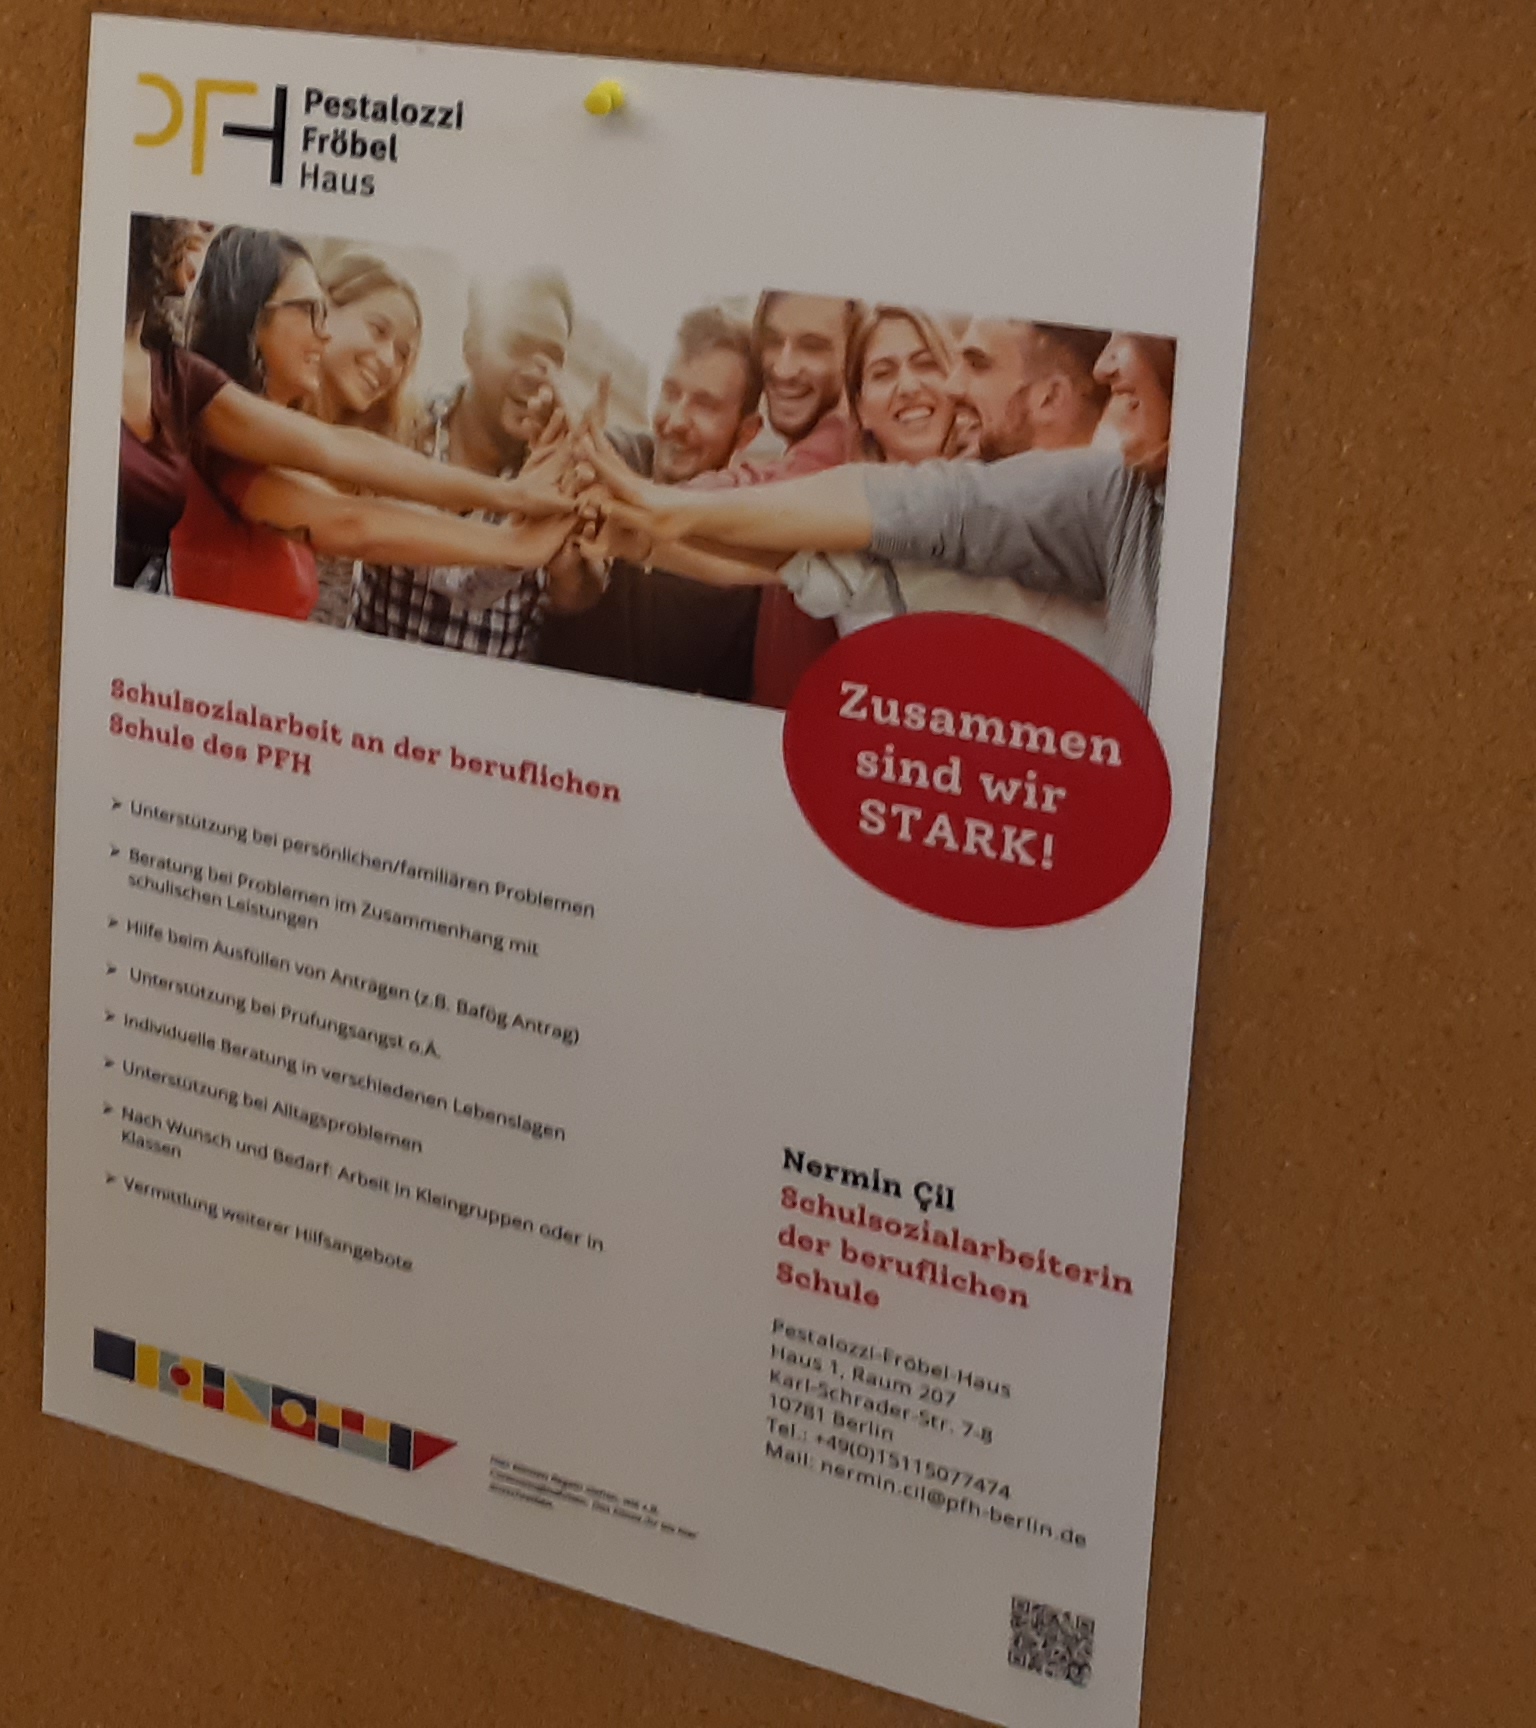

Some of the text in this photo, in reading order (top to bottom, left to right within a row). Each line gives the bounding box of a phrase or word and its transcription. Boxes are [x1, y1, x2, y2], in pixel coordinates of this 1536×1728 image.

[301, 125, 398, 163] Fröbel
[303, 86, 464, 131] Pestalozzi
[299, 160, 375, 197] Haus
[108, 711, 311, 776] Schule des PFH
[109, 677, 621, 803] Schulsozialarbeit an der beruflichen
[838, 679, 1122, 767] Zusammen
[855, 743, 1067, 814] sind wir
[129, 799, 248, 844] Unterstützung
[251, 826, 278, 847] bei
[493, 880, 595, 919] Problemen
[858, 797, 1054, 870] STARK!
[127, 874, 319, 930] schulischen Leistungen
[128, 846, 538, 957] Beratung bei Problemen im Zusammenhang mit
[126, 918, 163, 942] Hilfe
[167, 926, 209, 953] beim
[211, 938, 290, 973] Ausfüllen
[294, 961, 326, 981] von
[329, 967, 410, 1001] Anträgen
[129, 965, 246, 1014] Unterstützung
[249, 996, 276, 1017] bei
[280, 1004, 404, 1050] Prüfungsangst
[121, 1058, 423, 1153] Unterstützung bei Alltagsproblemen
[122, 1012, 566, 1142] Individuelle Beratung in verschiedenen Lebenslagen
[120, 1128, 182, 1159] Klassen
[120, 1105, 162, 1130] Nach
[165, 1117, 231, 1150] Wunsch
[235, 1139, 268, 1160] und
[336, 1165, 389, 1193] Arbeit
[394, 1180, 411, 1199] in
[415, 1185, 534, 1233] Kleingruppen
[538, 1223, 582, 1246] oder
[586, 1233, 604, 1252] in
[782, 1146, 954, 1213] Nermin Çil
[122, 1175, 413, 1272] Vermittlung weiterer Hilfsangebote
[780, 1185, 1133, 1296] Schulsozialarbeiterin
[775, 1261, 880, 1308] Schule
[777, 1224, 1029, 1309] der beruflichen
[770, 1342, 822, 1372] Haus
[851, 1365, 912, 1396] Raum
[831, 1409, 893, 1442] Berlin
